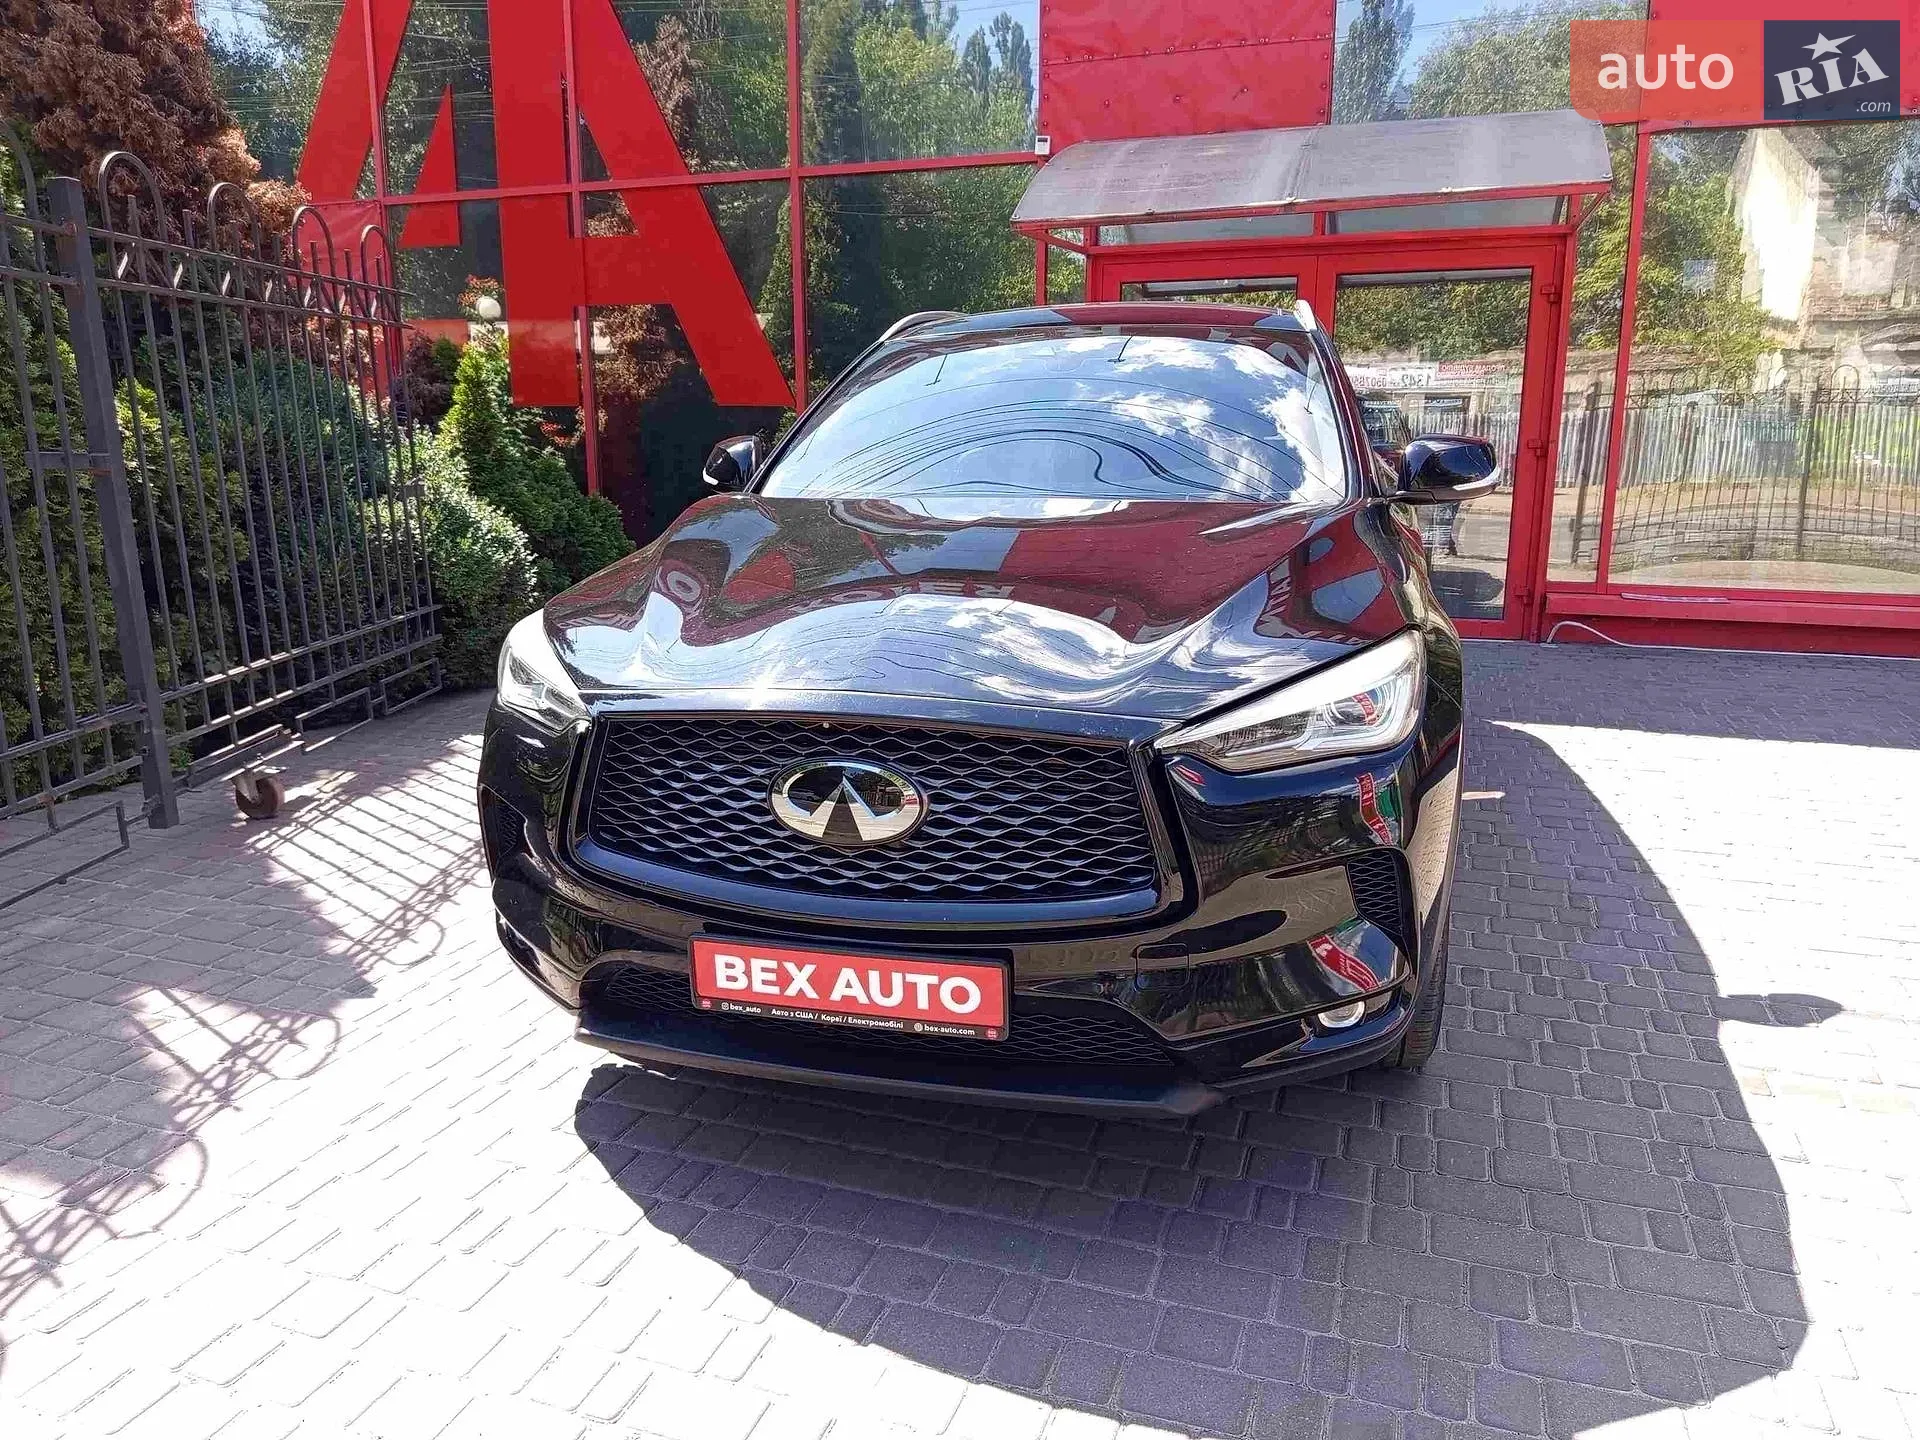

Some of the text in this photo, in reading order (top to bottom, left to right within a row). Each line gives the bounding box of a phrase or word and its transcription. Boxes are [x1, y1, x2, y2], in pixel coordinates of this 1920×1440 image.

[714, 953, 982, 1015] BEX AUTO
[729, 1002, 762, 1014] bex_auto
[795, 1010, 814, 1020] США
[924, 1022, 976, 1036] bex-auto.com
